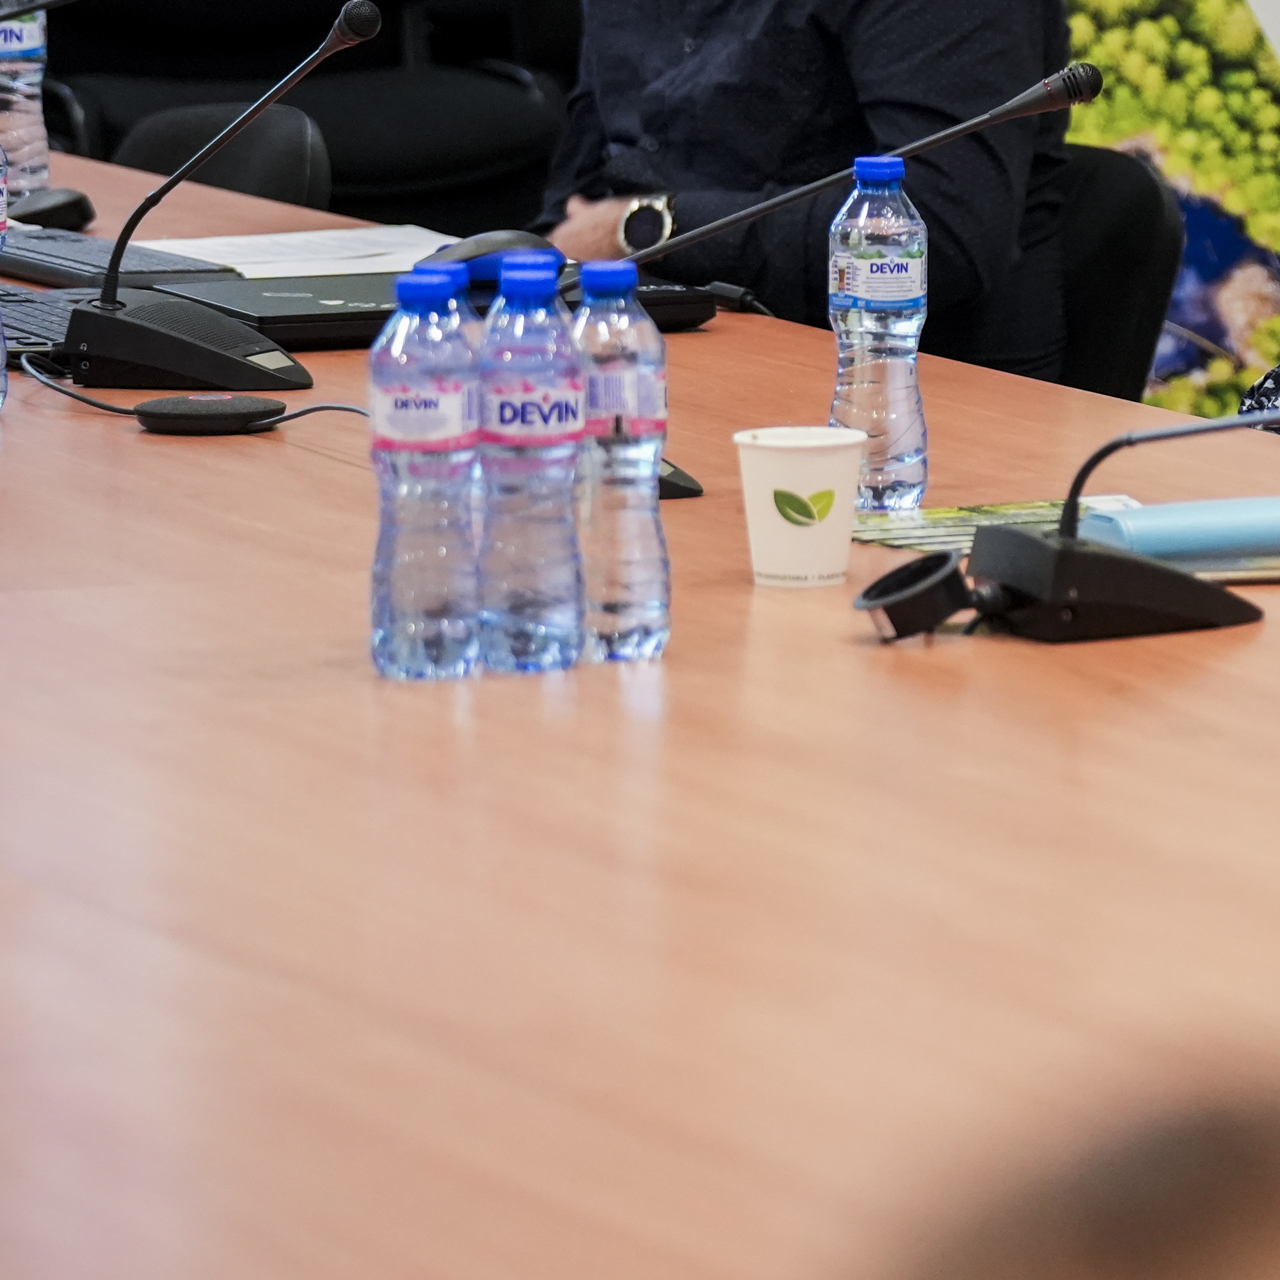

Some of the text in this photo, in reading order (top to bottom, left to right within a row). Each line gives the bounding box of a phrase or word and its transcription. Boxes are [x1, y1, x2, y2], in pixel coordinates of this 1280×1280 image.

[870, 262, 909, 274] DEVIN
[394, 397, 439, 411] DEVIN
[499, 398, 579, 426] DEVIN
